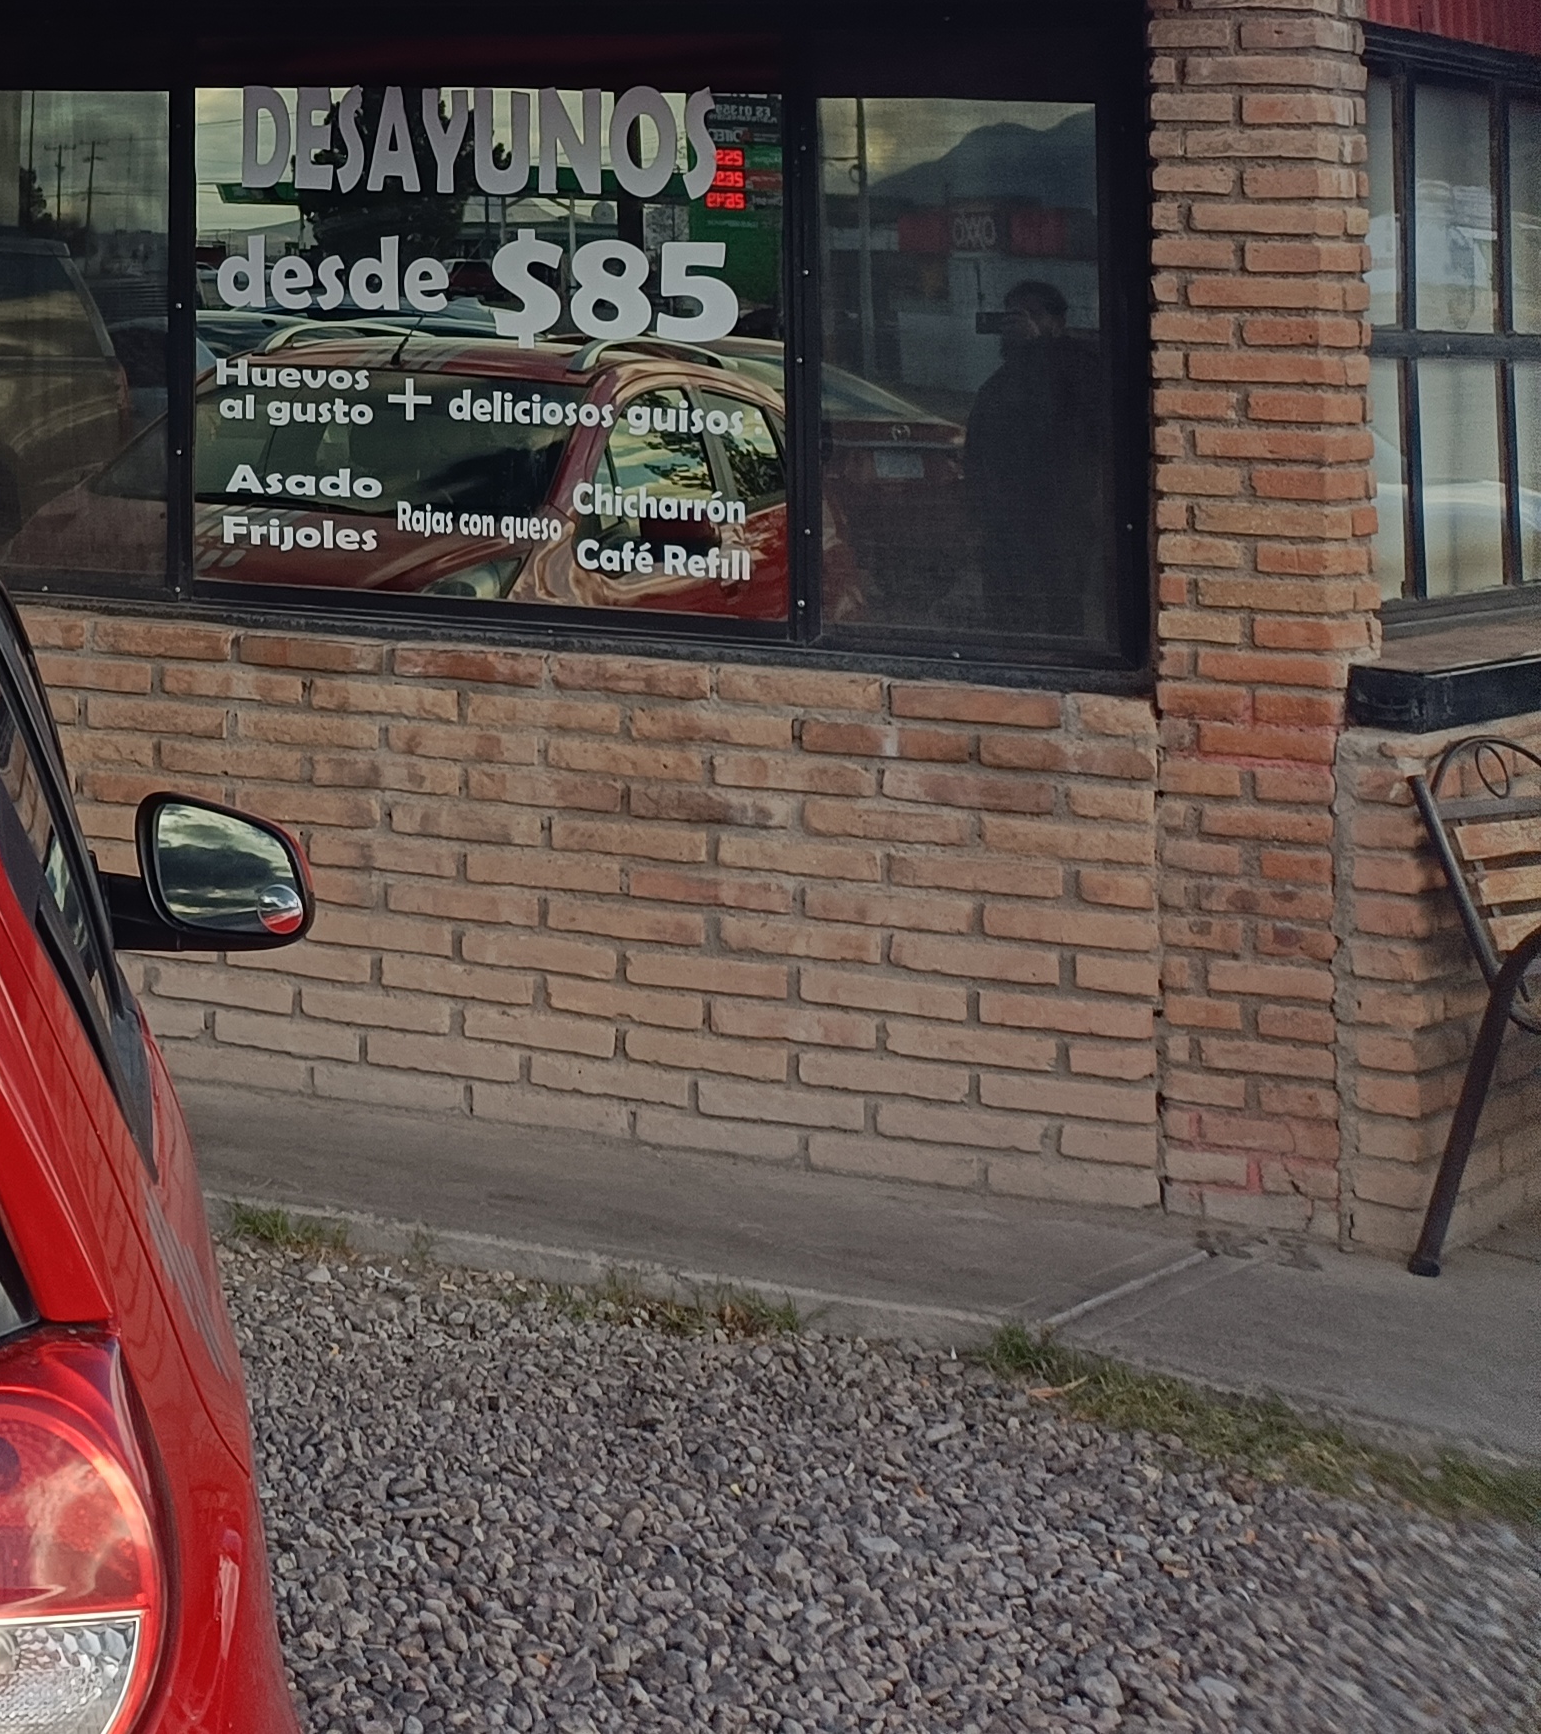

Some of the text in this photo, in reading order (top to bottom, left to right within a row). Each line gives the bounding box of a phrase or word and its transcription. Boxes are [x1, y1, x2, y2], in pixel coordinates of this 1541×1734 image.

[241, 85, 718, 200] DESAYUNOS
[216, 229, 739, 348] desde $85
[216, 358, 370, 390] Huevos
[219, 394, 374, 426] al gusto
[448, 389, 615, 428] deliciosos
[225, 464, 383, 499] Asado
[397, 501, 562, 544] Rajas con queso
[572, 482, 746, 524] Chicharrón
[222, 516, 377, 551] Frijoles
[576, 539, 751, 581] Café Refill
